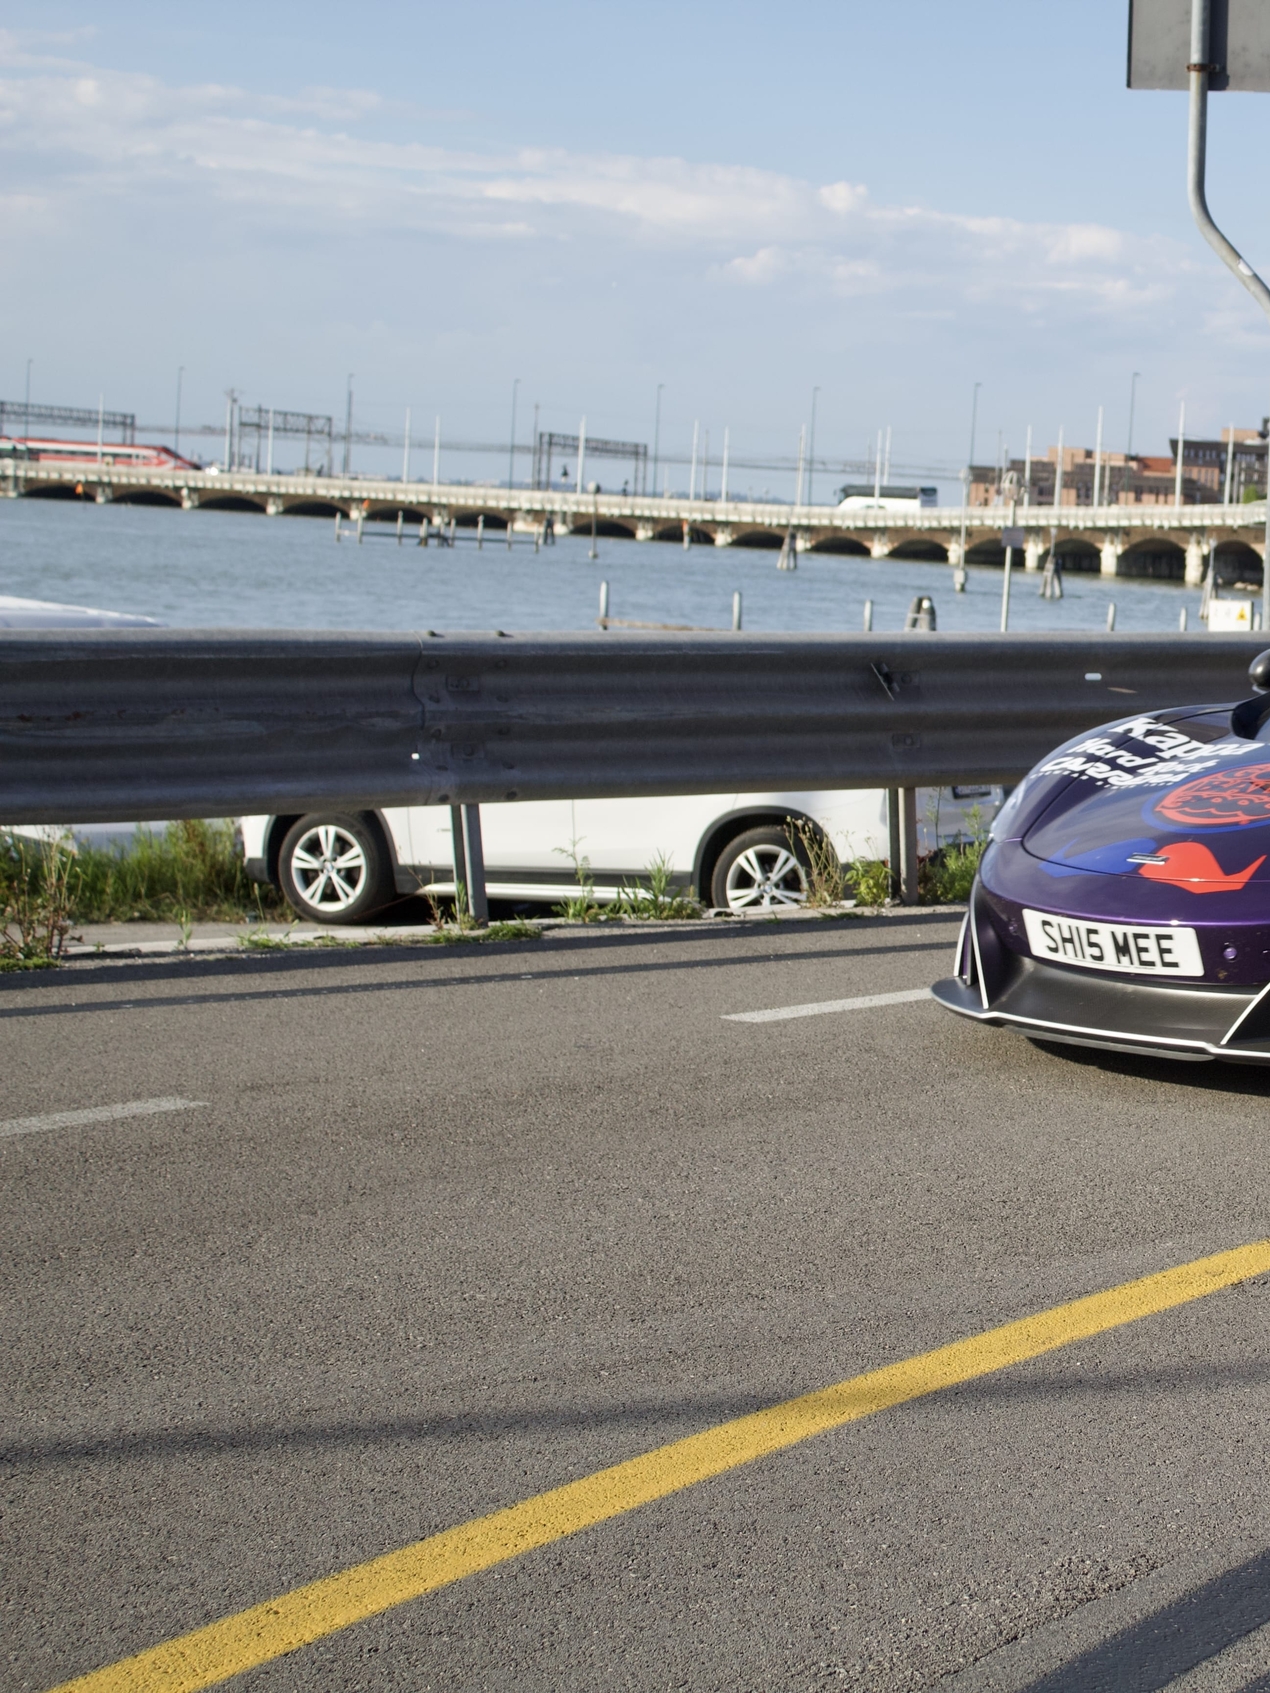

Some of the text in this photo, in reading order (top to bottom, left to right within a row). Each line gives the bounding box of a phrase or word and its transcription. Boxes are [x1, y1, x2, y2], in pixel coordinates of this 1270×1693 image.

[1067, 737, 1158, 767] Hard
[1108, 717, 1265, 760] Kappa
[1042, 920, 1179, 968] SH15 MEE
